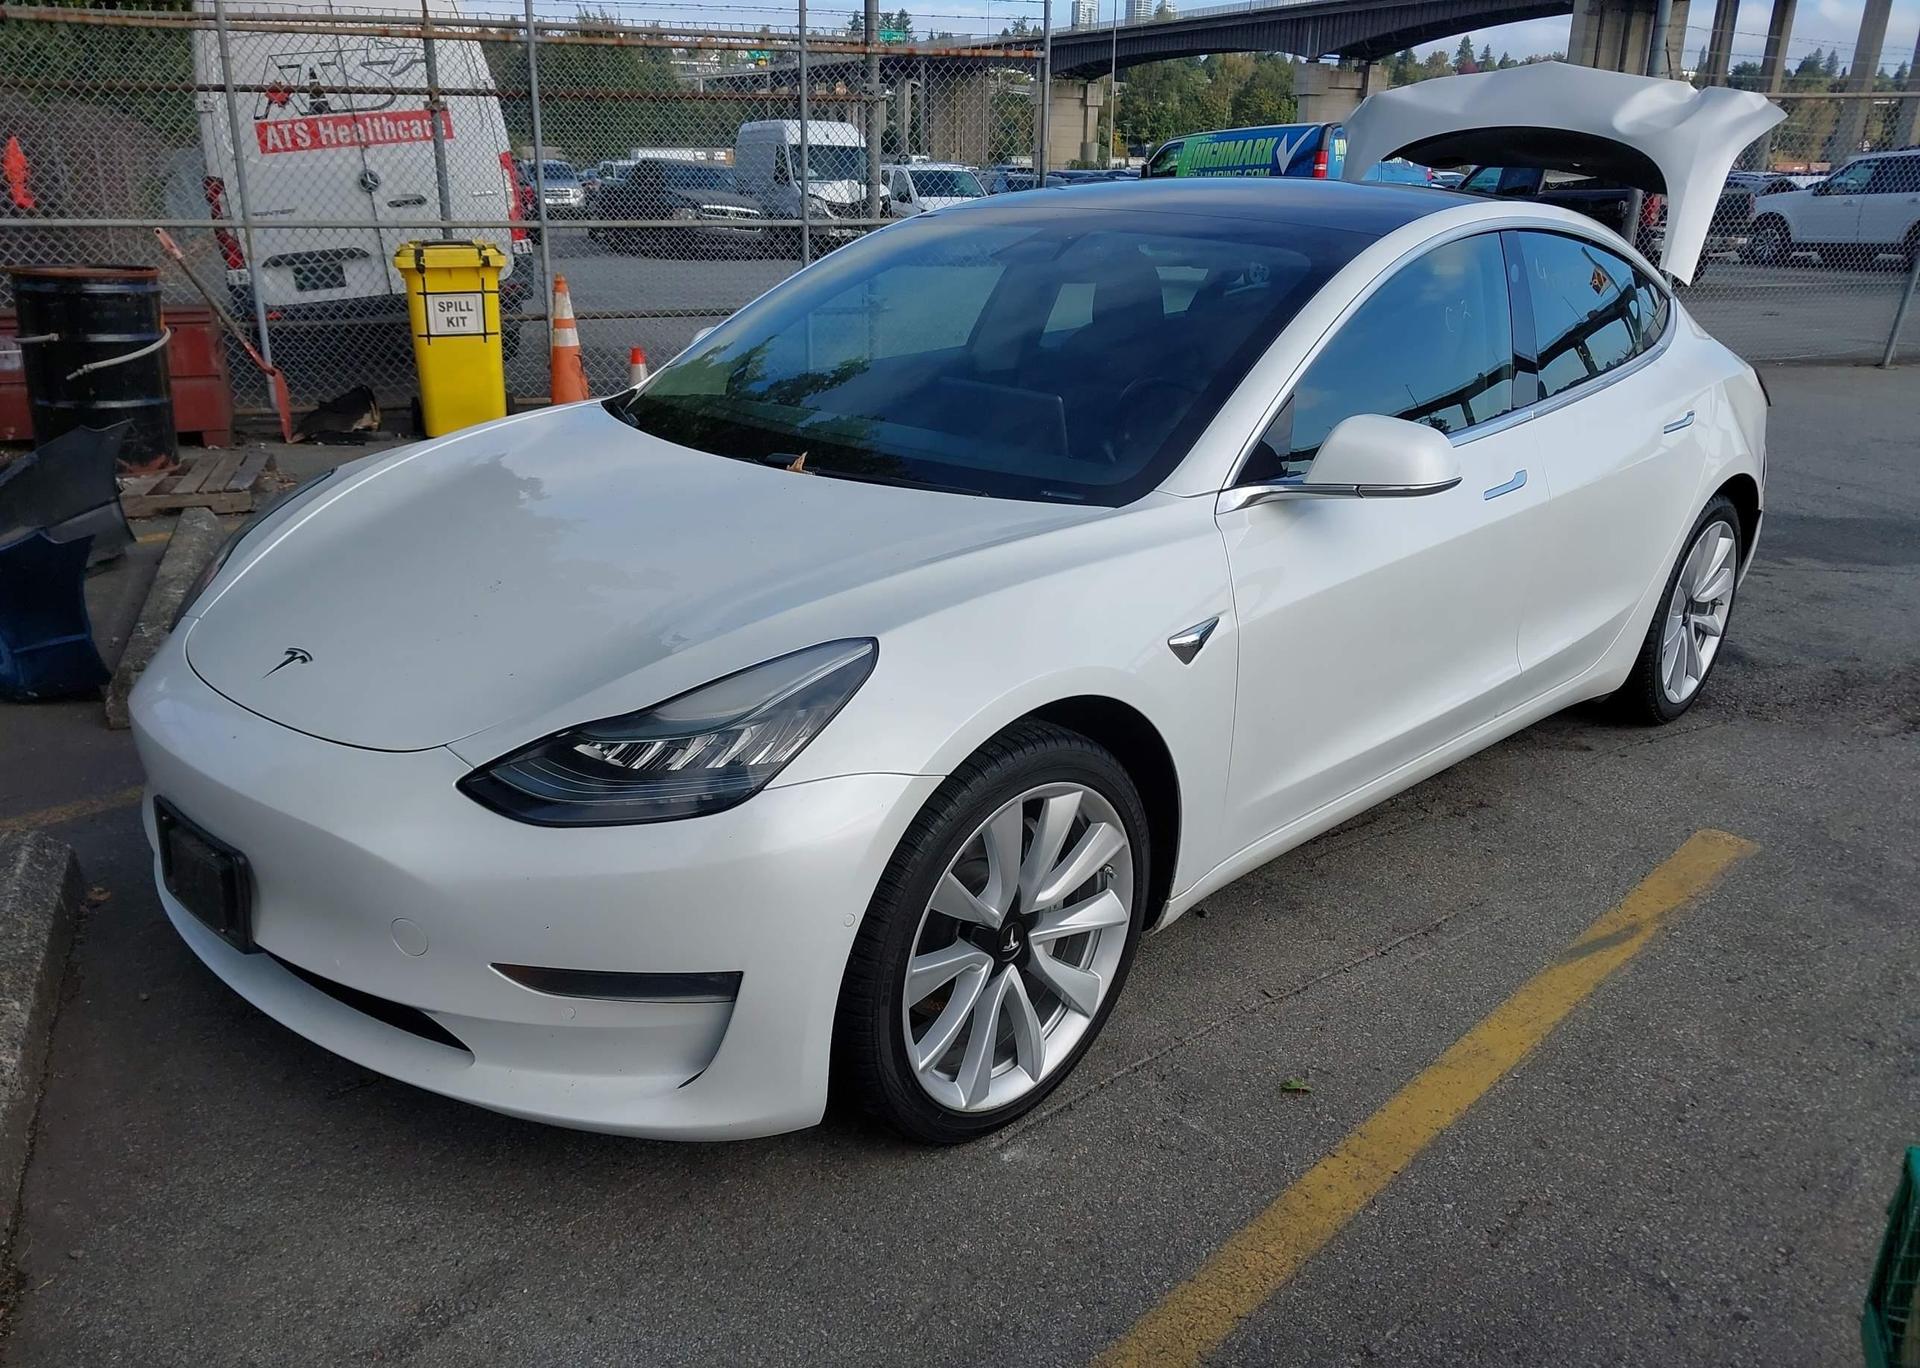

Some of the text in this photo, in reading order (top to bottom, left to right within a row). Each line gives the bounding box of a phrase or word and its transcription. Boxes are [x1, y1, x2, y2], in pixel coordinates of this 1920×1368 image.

[265, 122, 312, 151] ATS
[1191, 137, 1278, 169] HIGHMARK
[438, 301, 473, 312] SPILL
[447, 316, 467, 327] KIT
